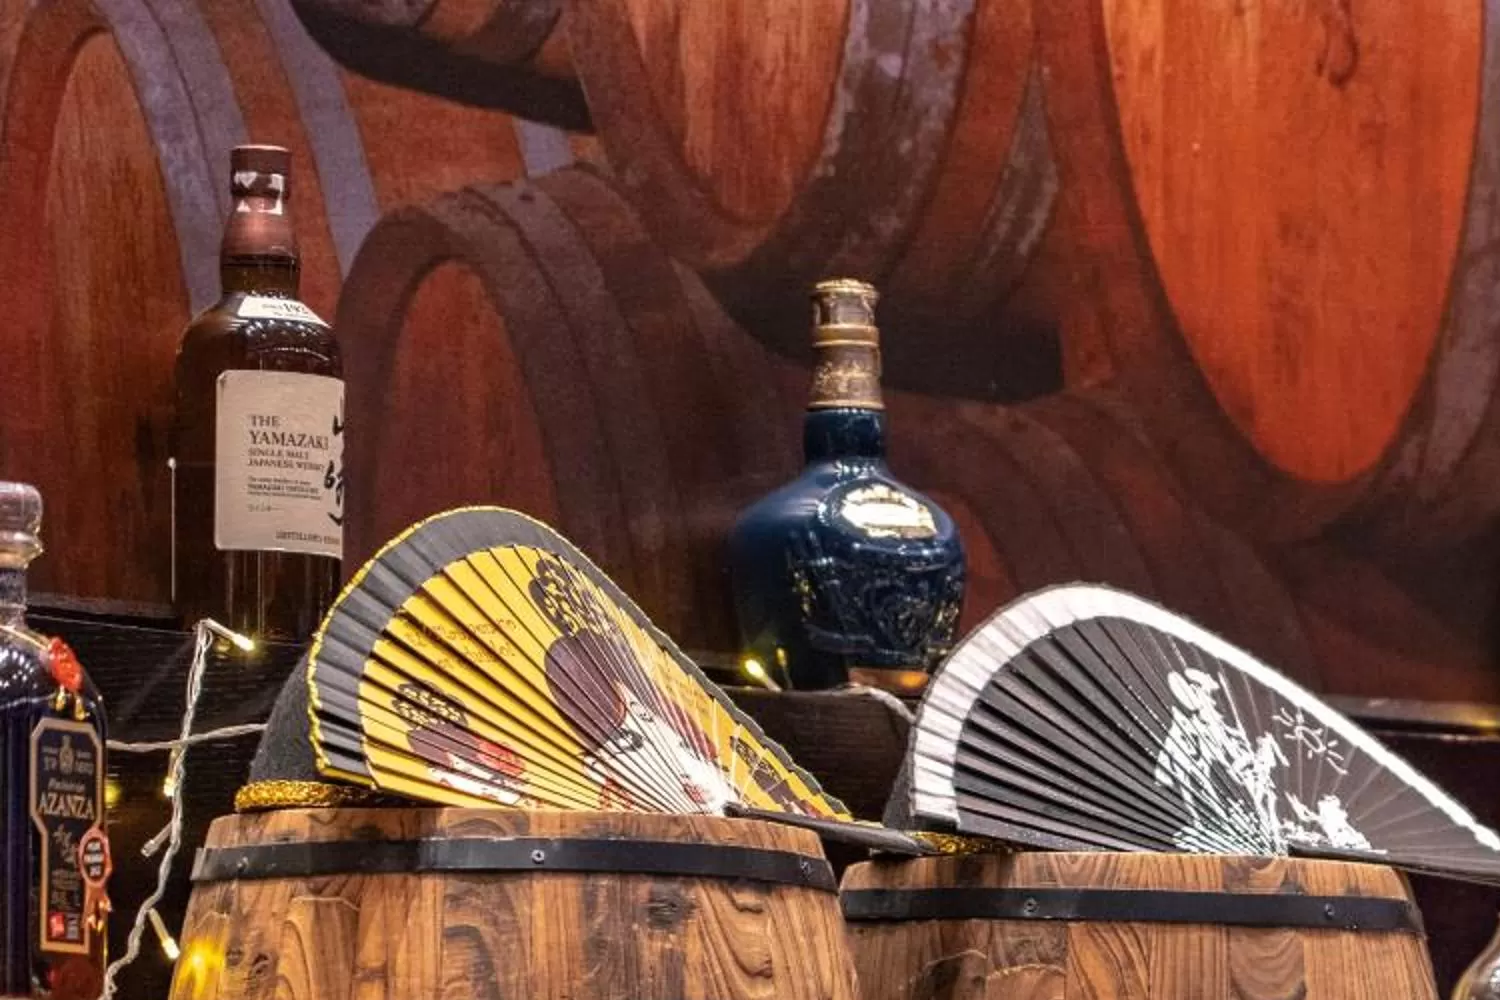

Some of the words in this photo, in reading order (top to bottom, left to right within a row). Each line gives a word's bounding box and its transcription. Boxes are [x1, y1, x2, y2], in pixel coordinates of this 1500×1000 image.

[249, 415, 280, 428] THE
[249, 430, 329, 450] YAMAZAKI
[40, 791, 95, 820] AZANZA
